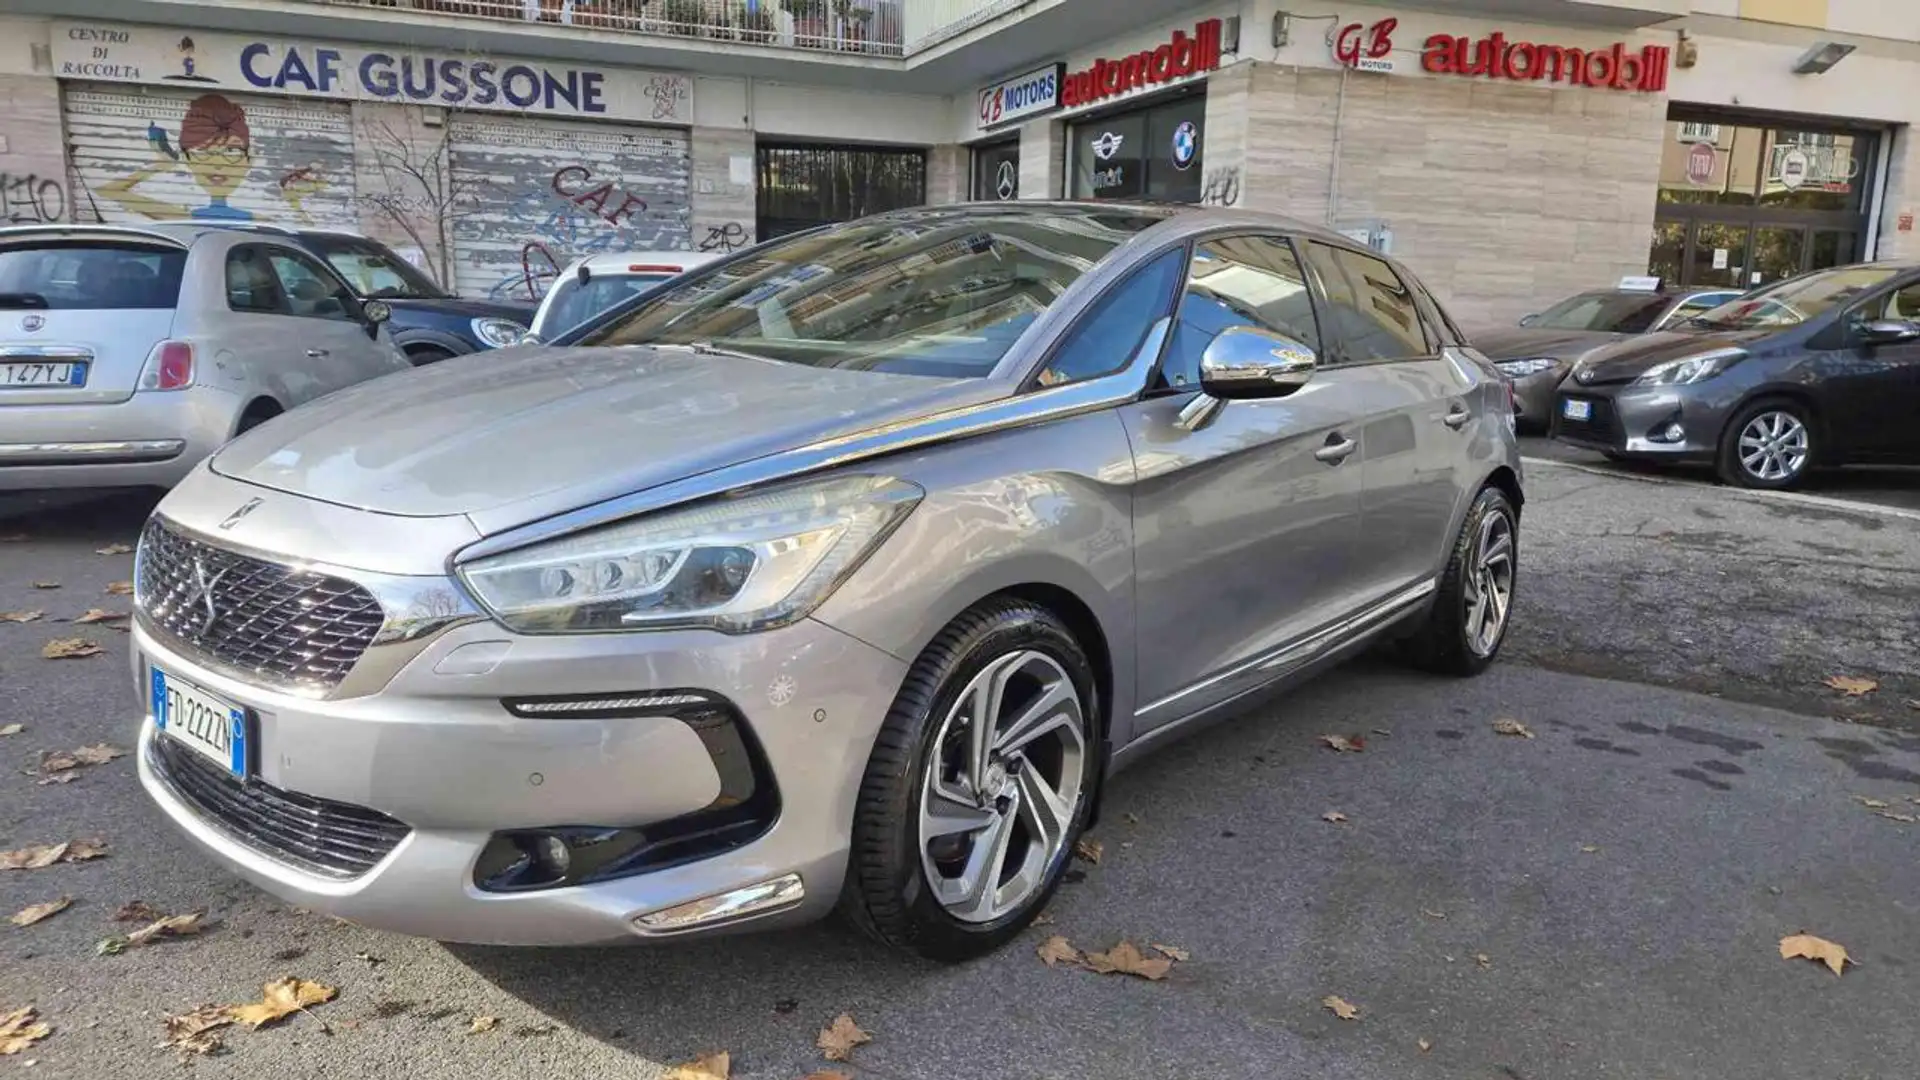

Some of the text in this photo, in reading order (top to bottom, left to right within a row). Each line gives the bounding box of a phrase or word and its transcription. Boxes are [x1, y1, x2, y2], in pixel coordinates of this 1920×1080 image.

[68, 27, 130, 43] CENTRO
[92, 46, 109, 59] DI
[62, 61, 141, 79] RACCOLTA
[1360, 60, 1393, 70] MOTORS
[239, 42, 606, 113] CAF GUSSONE
[1004, 73, 1055, 112] MOTORS
